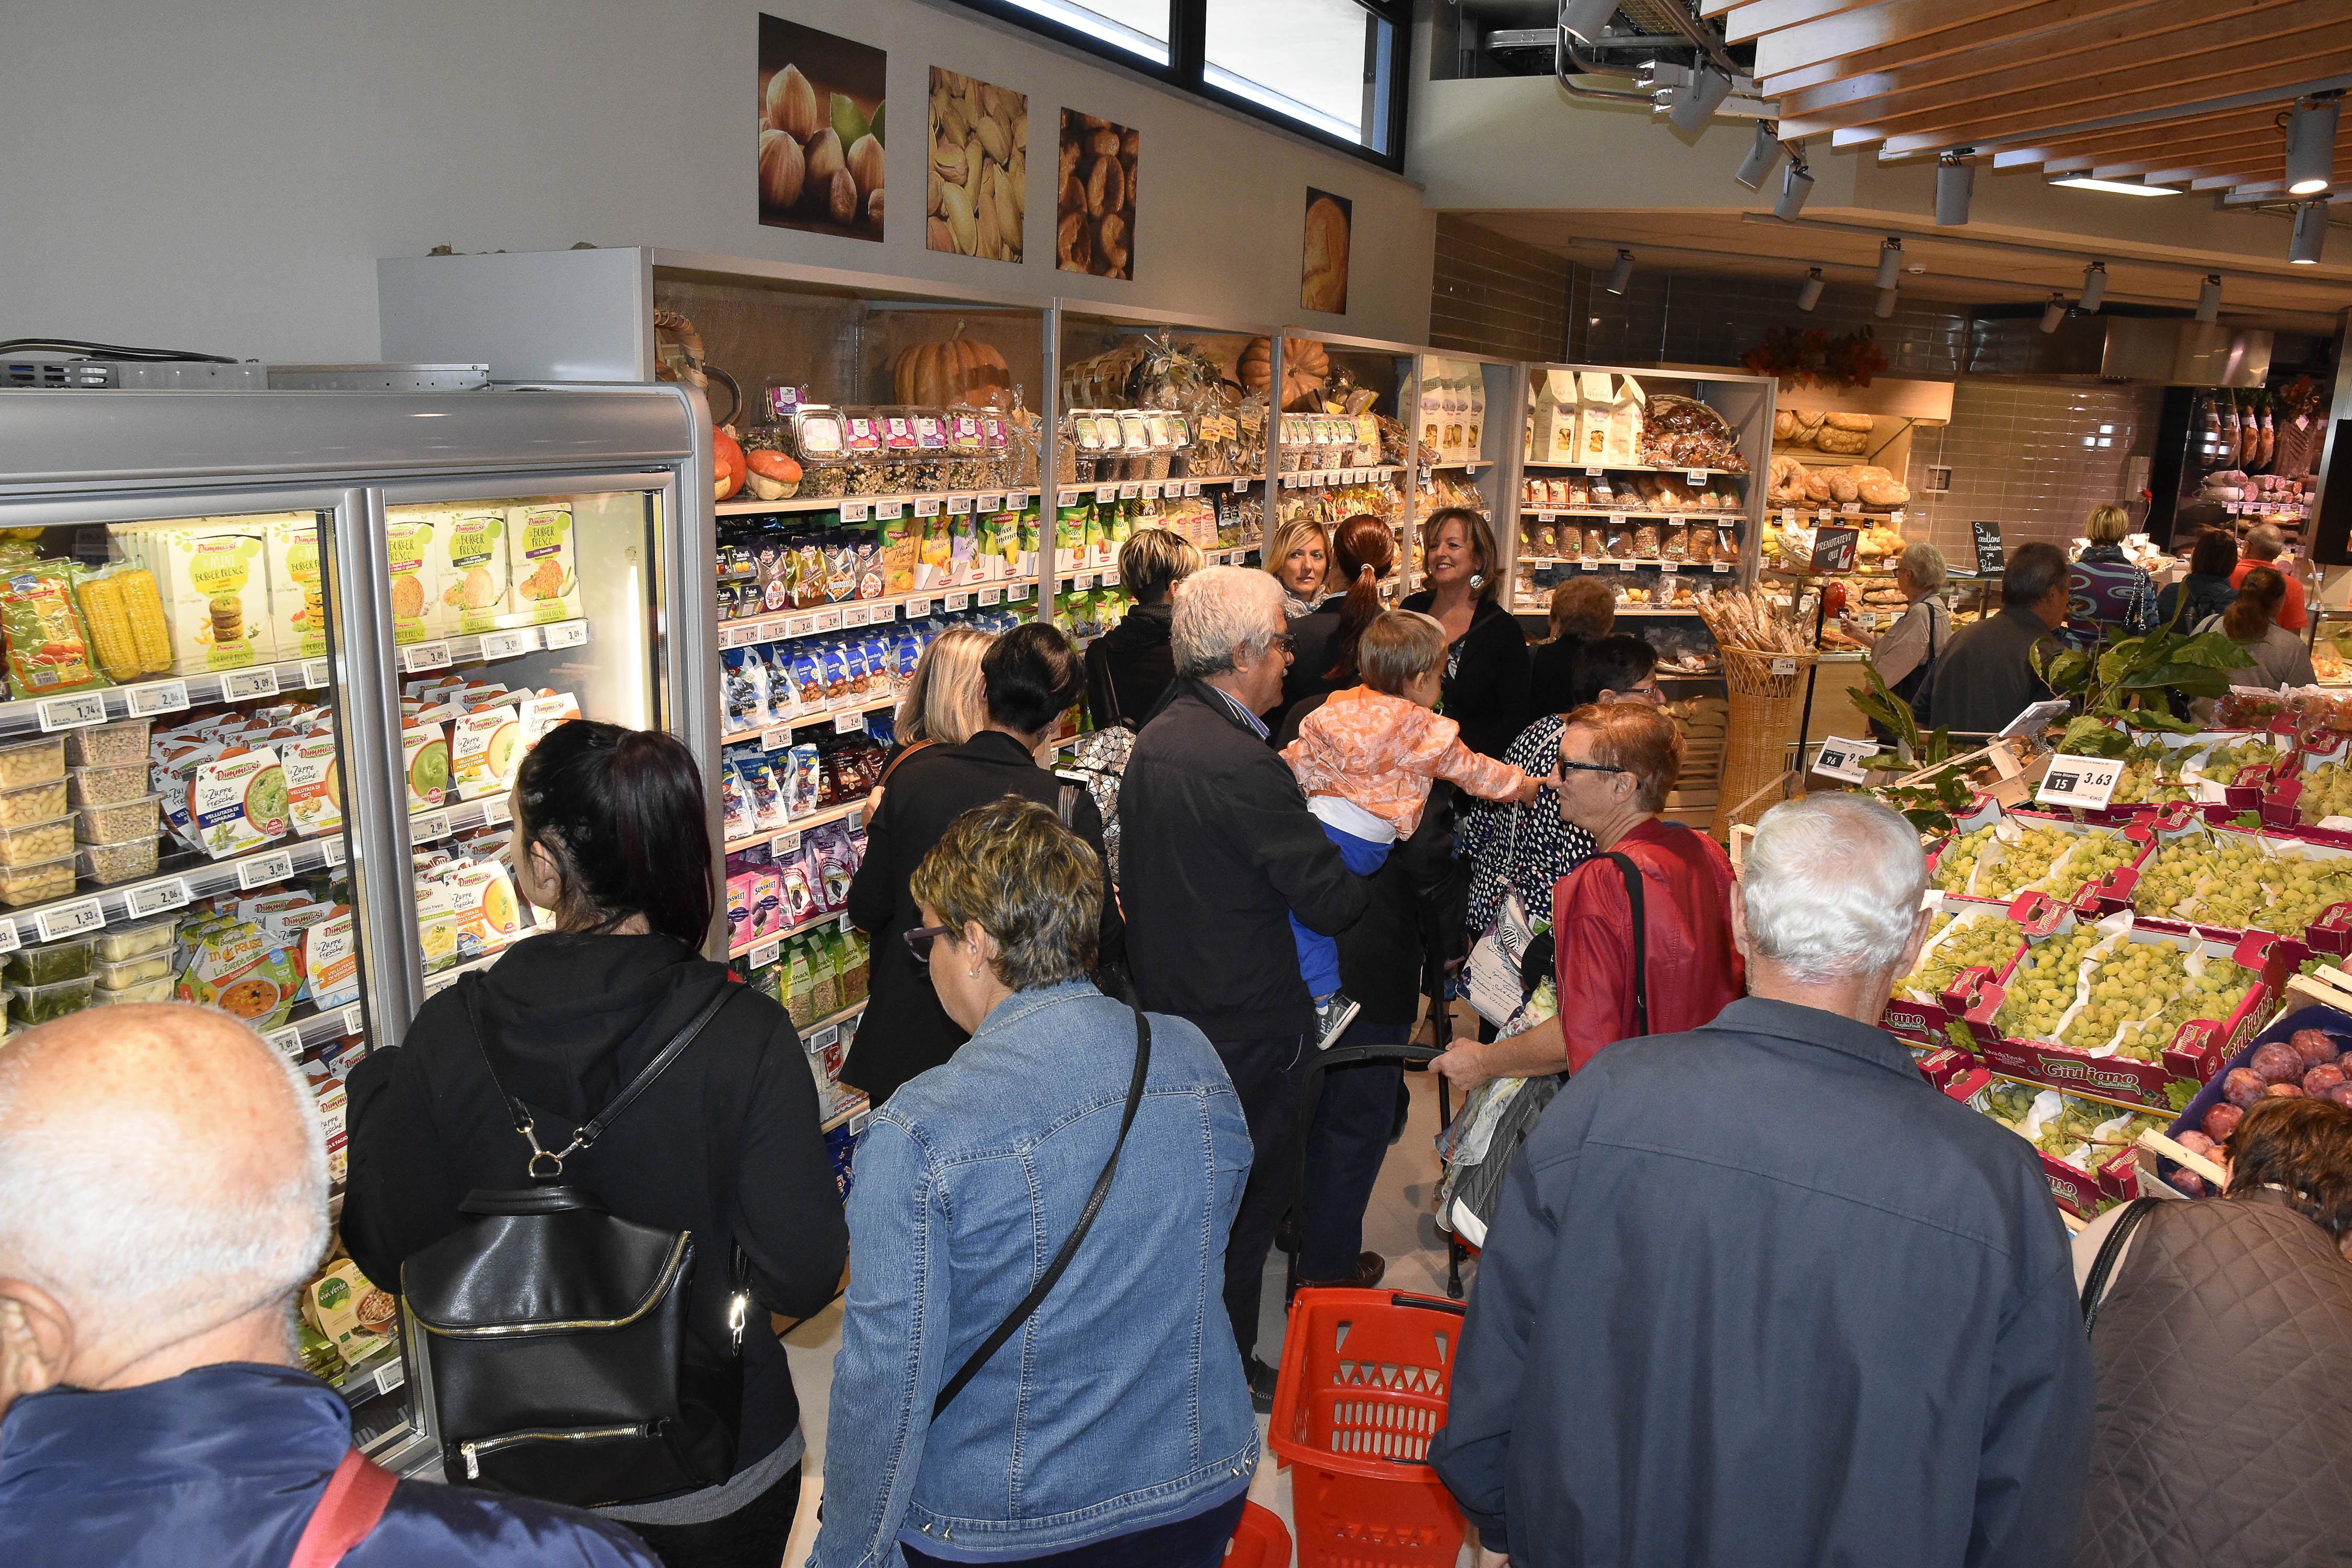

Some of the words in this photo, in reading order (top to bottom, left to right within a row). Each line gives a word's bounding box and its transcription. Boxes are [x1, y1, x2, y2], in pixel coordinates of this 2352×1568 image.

[534, 526, 554, 537] BURGER
[996, 525, 1012, 536] Viva
[1975, 523, 1984, 534] Si
[389, 539, 414, 550] BURGER
[461, 534, 485, 545] BURGER
[532, 537, 552, 547] FRESCO
[1816, 533, 1852, 552] PRENOTATEVI
[460, 546, 482, 556] FRESCO
[732, 550, 750, 559] Melinda
[1828, 549, 1838, 561] QUI
[292, 560, 314, 572] BURGER
[195, 568, 220, 582] BURGER
[829, 581, 852, 589] BENESSERE
[569, 630, 579, 640] 3,09
[746, 631, 754, 640] 1,29
[506, 640, 517, 650] 3,09
[430, 651, 443, 662] 3,09
[254, 679, 269, 690] 3,09
[162, 692, 179, 705] 2,06
[77, 706, 95, 719] 1,74
[463, 736, 480, 746] Zuppe
[299, 743, 336, 758] Dimmidis
[460, 743, 481, 754] fresche
[458, 756, 478, 765] VELLUTATA
[1826, 756, 1837, 765] 96
[1849, 753, 1864, 764] 9,9
[216, 760, 260, 781] Dimmidisì
[294, 765, 314, 776] Zuppe
[292, 773, 317, 784] fresche
[2055, 779, 2069, 789] 15
[2084, 773, 2112, 786] 3,63
[209, 786, 232, 800] Zuppe
[290, 786, 315, 795] VELLUTATA
[206, 794, 235, 808] fresche
[205, 808, 233, 820] VELLUTATA
[210, 813, 236, 824] ASPARAGI
[2172, 804, 2188, 827] Giuliano
[431, 823, 443, 834] 2,89
[269, 863, 283, 875] 3,09
[755, 881, 776, 895] SUNSWEET
[161, 890, 178, 903] 2,06
[454, 892, 472, 903] Zuppe
[727, 892, 745, 904] UNSWEET
[454, 898, 475, 909] fresche
[75, 911, 94, 925] 1,33
[282, 909, 324, 927] Dimmidisì
[2040, 903, 2059, 931] Giuliano
[324, 922, 353, 937] Dimmi
[320, 938, 342, 950] Zuppe
[319, 946, 343, 959] fresche
[224, 958, 246, 972] Zuppe
[328, 961, 354, 976] VELLUTATA
[818, 959, 829, 967] Snack
[229, 964, 252, 981] Gazpacho
[335, 965, 356, 978] VERDURE
[792, 971, 809, 980] Snack
[1953, 971, 1971, 994] Giuliano
[1886, 1008, 1926, 1025] iano
[2178, 1024, 2195, 1054] Giuliano
[1926, 1047, 1952, 1067] Giuliano
[1984, 1048, 1996, 1056] Uva
[2005, 1053, 2026, 1063] Tavola
[2042, 1062, 2139, 1085] Giuliano
[320, 1093, 347, 1113] Dimmi
[325, 1123, 343, 1136] esche
[335, 1135, 348, 1146] FAGIO
[2112, 1148, 2137, 1173] Giuliano
[319, 1290, 331, 1301] vivi
